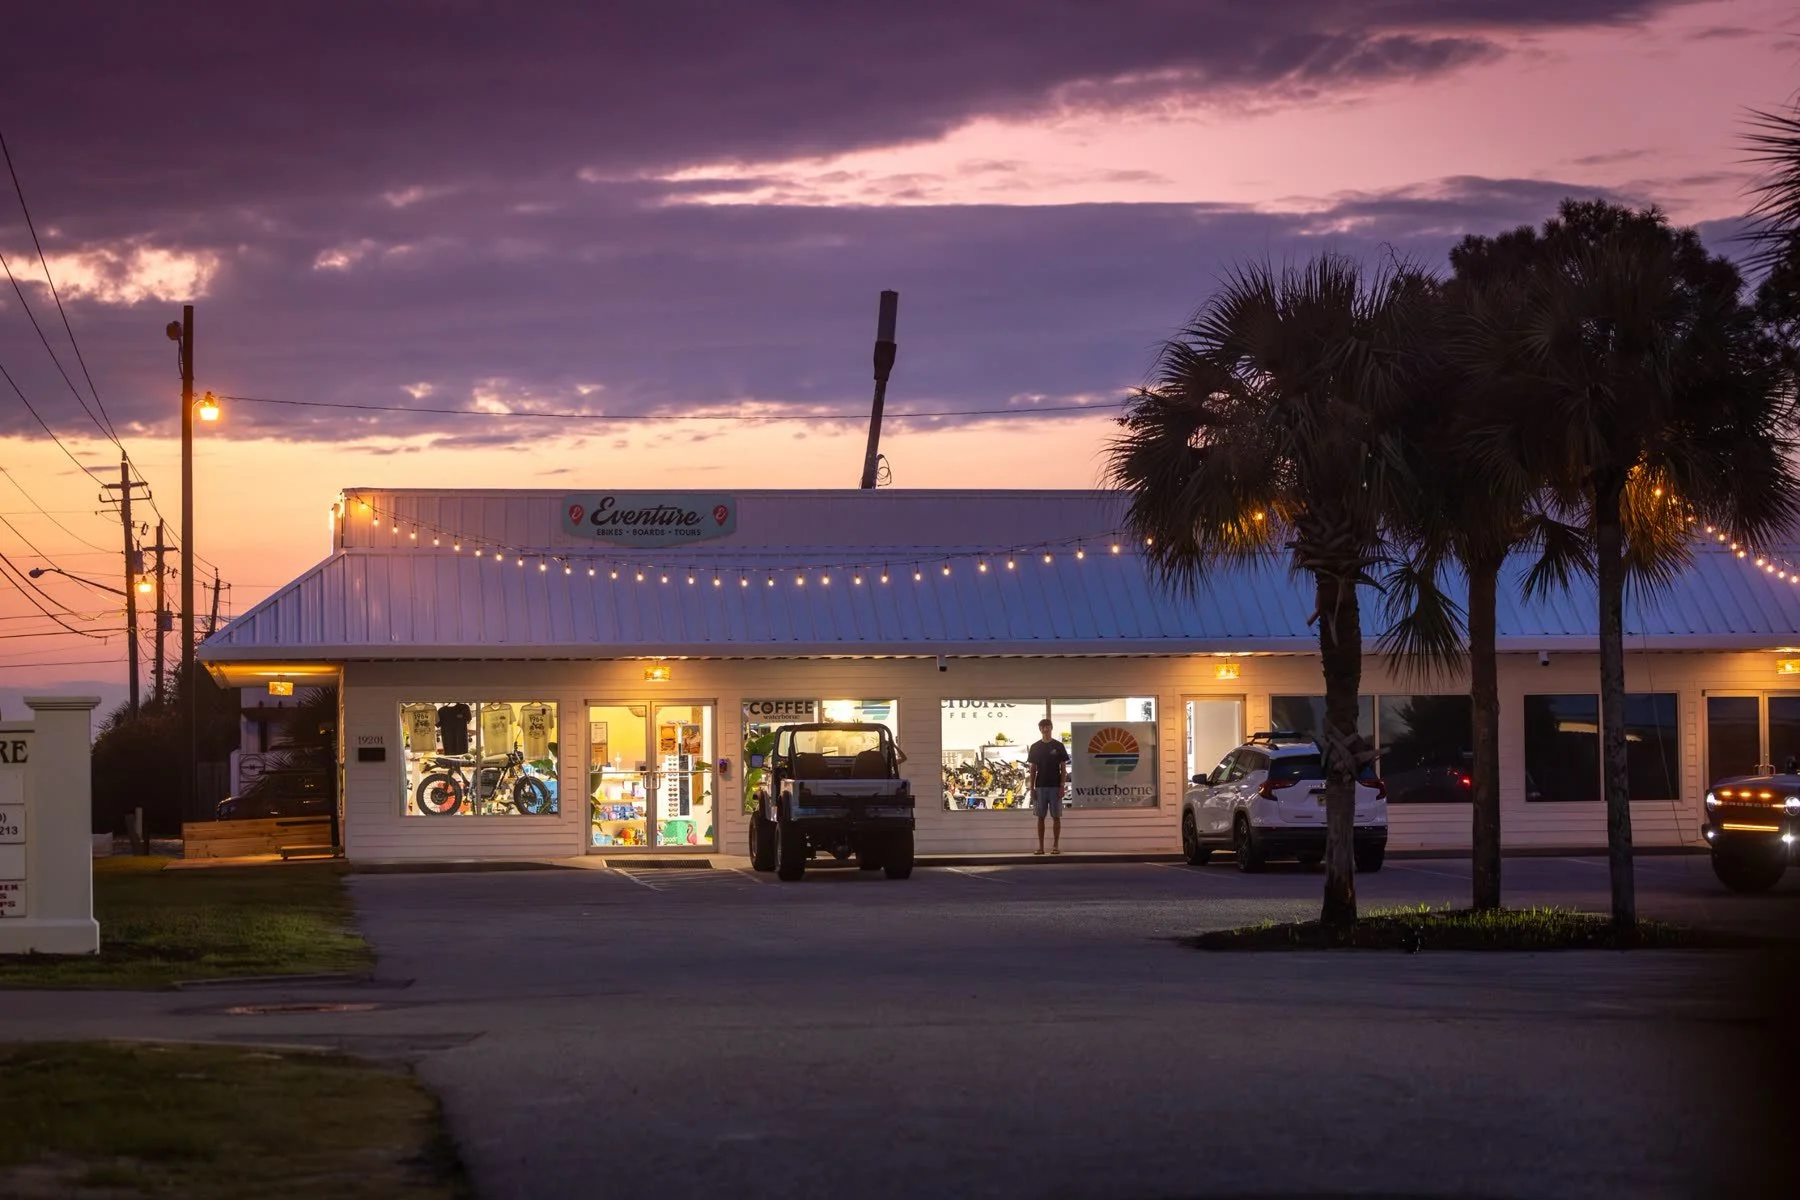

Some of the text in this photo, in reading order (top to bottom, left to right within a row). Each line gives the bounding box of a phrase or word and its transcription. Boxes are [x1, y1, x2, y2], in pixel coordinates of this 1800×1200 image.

[590, 496, 705, 526] Eventure
[596, 528, 701, 536] EBIKES BOARDS TOURS
[749, 701, 814, 715] COFFEE
[987, 711, 1009, 719] CO.
[358, 735, 384, 745] 19201
[1075, 784, 1154, 796] waterborne
